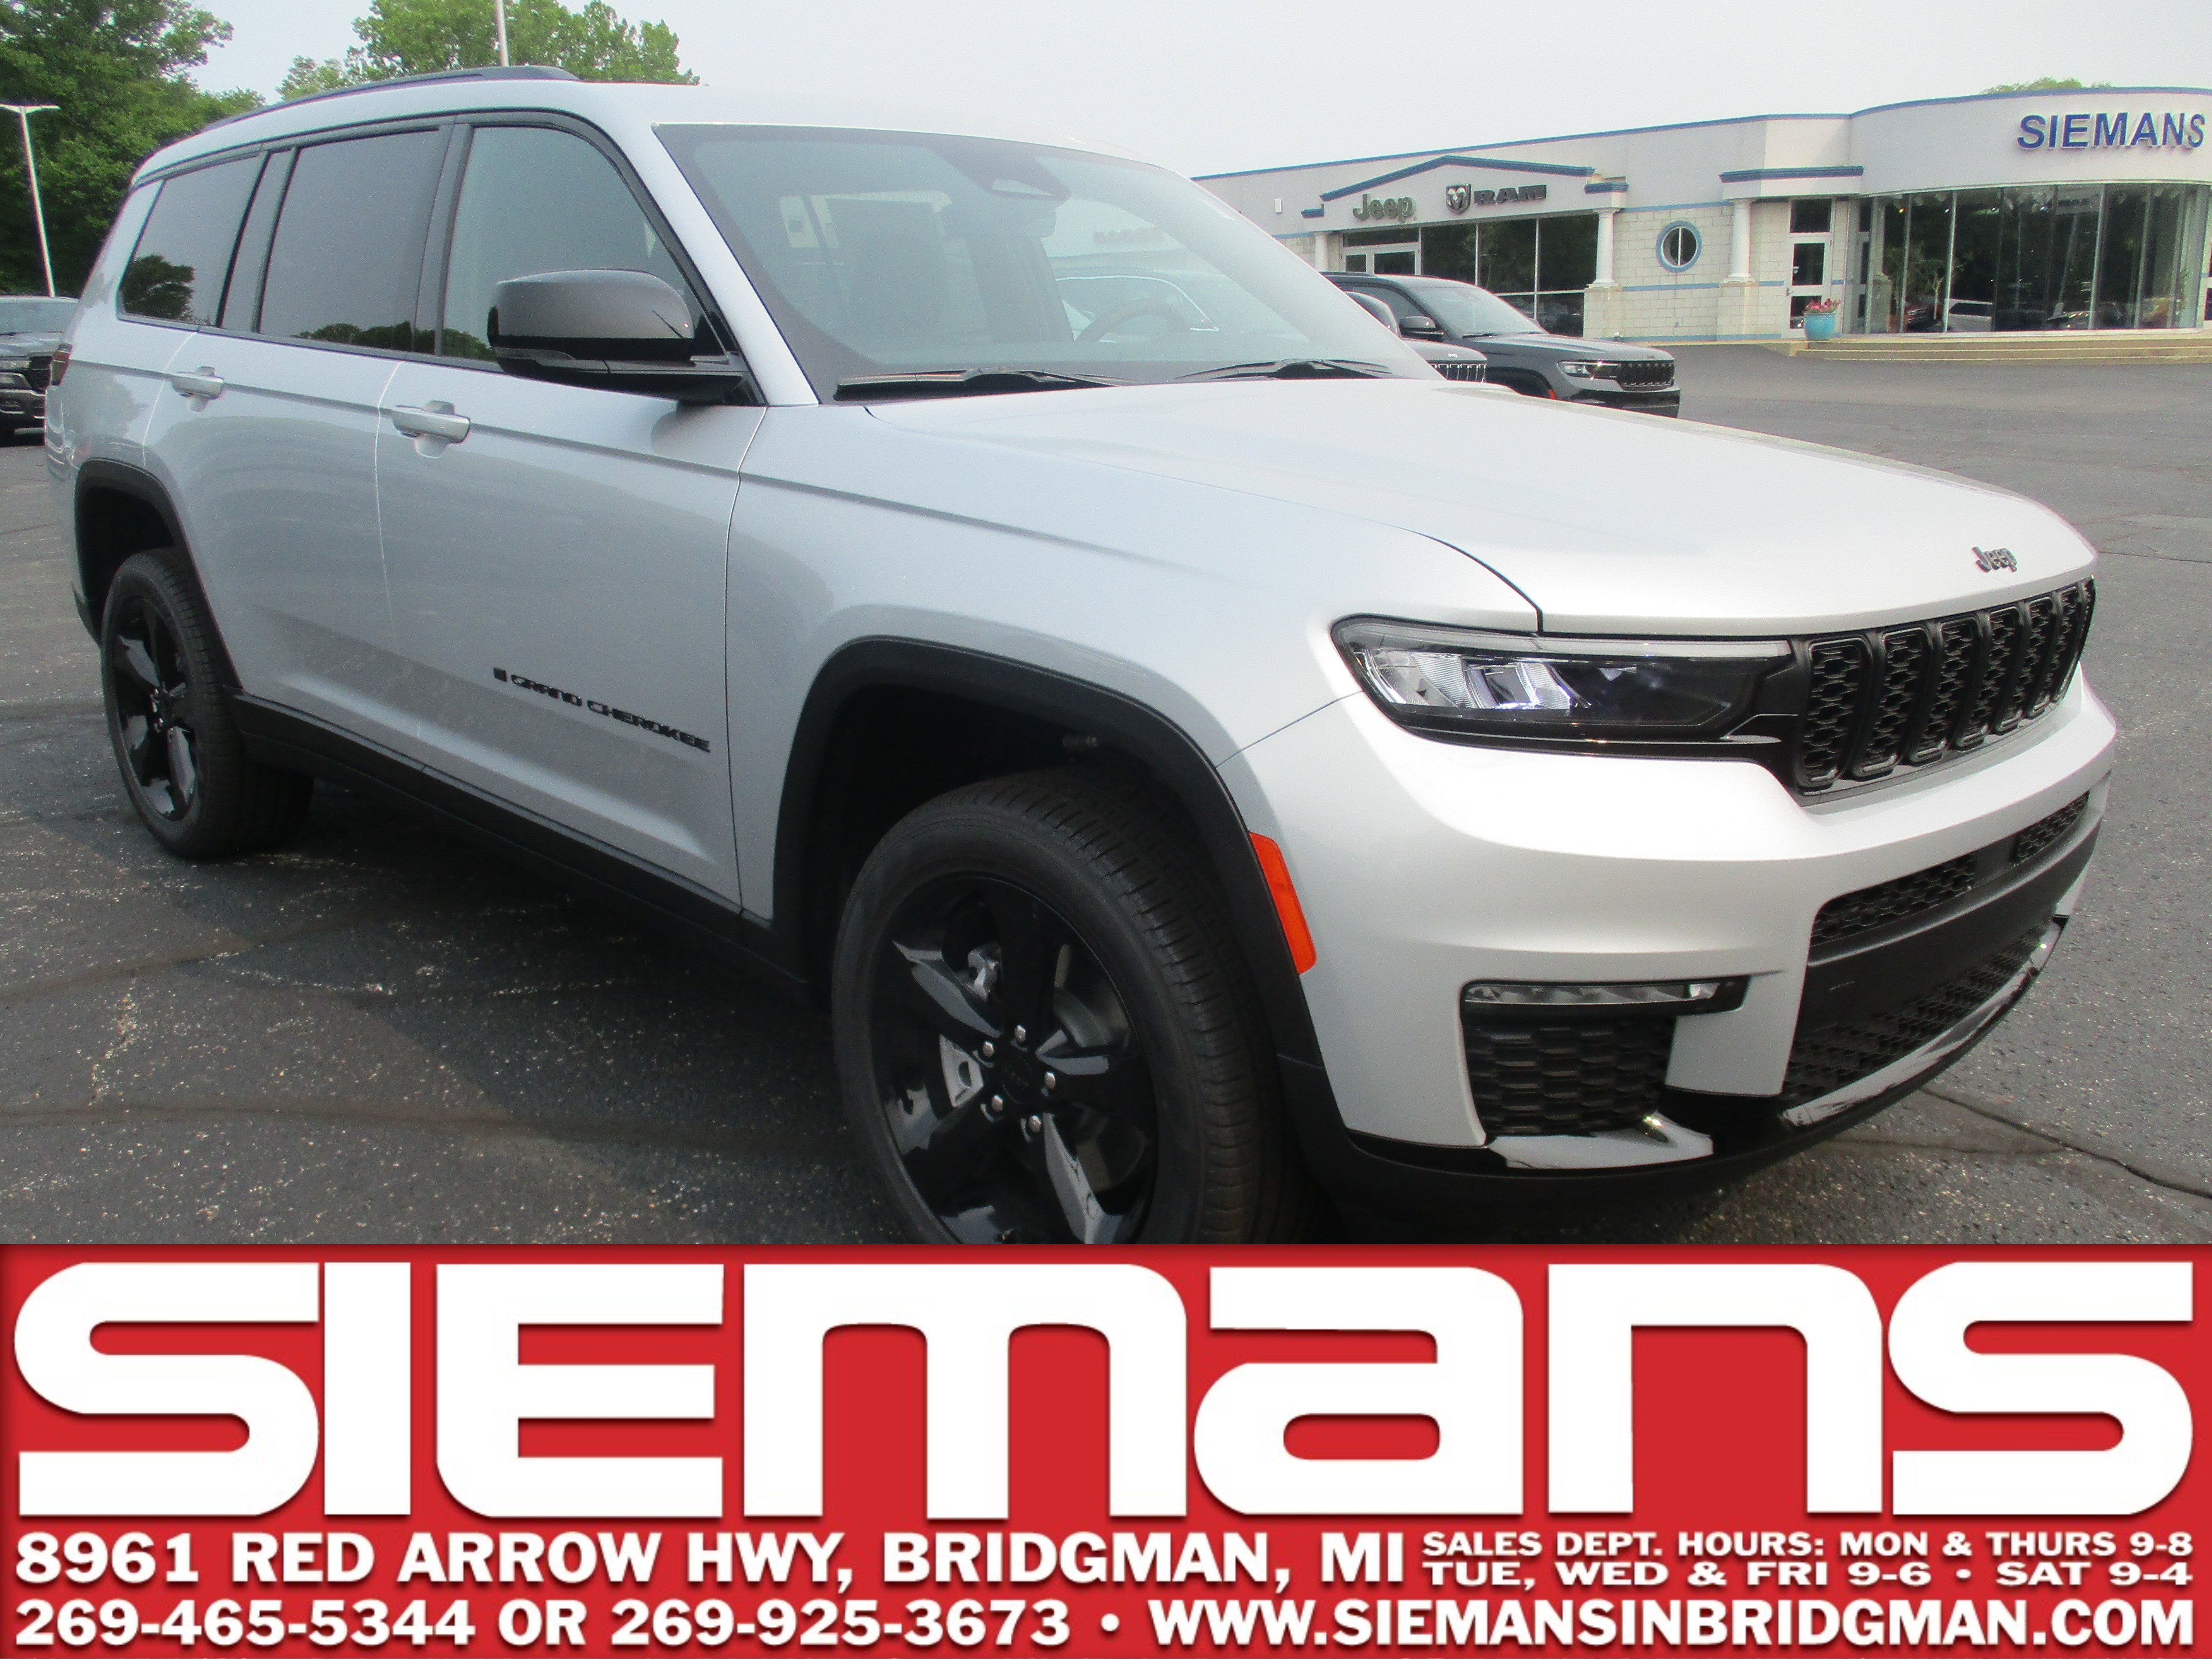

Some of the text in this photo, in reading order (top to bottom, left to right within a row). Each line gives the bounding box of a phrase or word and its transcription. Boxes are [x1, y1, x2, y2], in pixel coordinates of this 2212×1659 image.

[2017, 112, 2205, 150] SIEMANS
[1352, 193, 1416, 222] Jeep
[1474, 184, 1547, 205] RAM
[1972, 546, 2018, 572] Jeep
[511, 675, 711, 753] GRAND CHEROKEE
